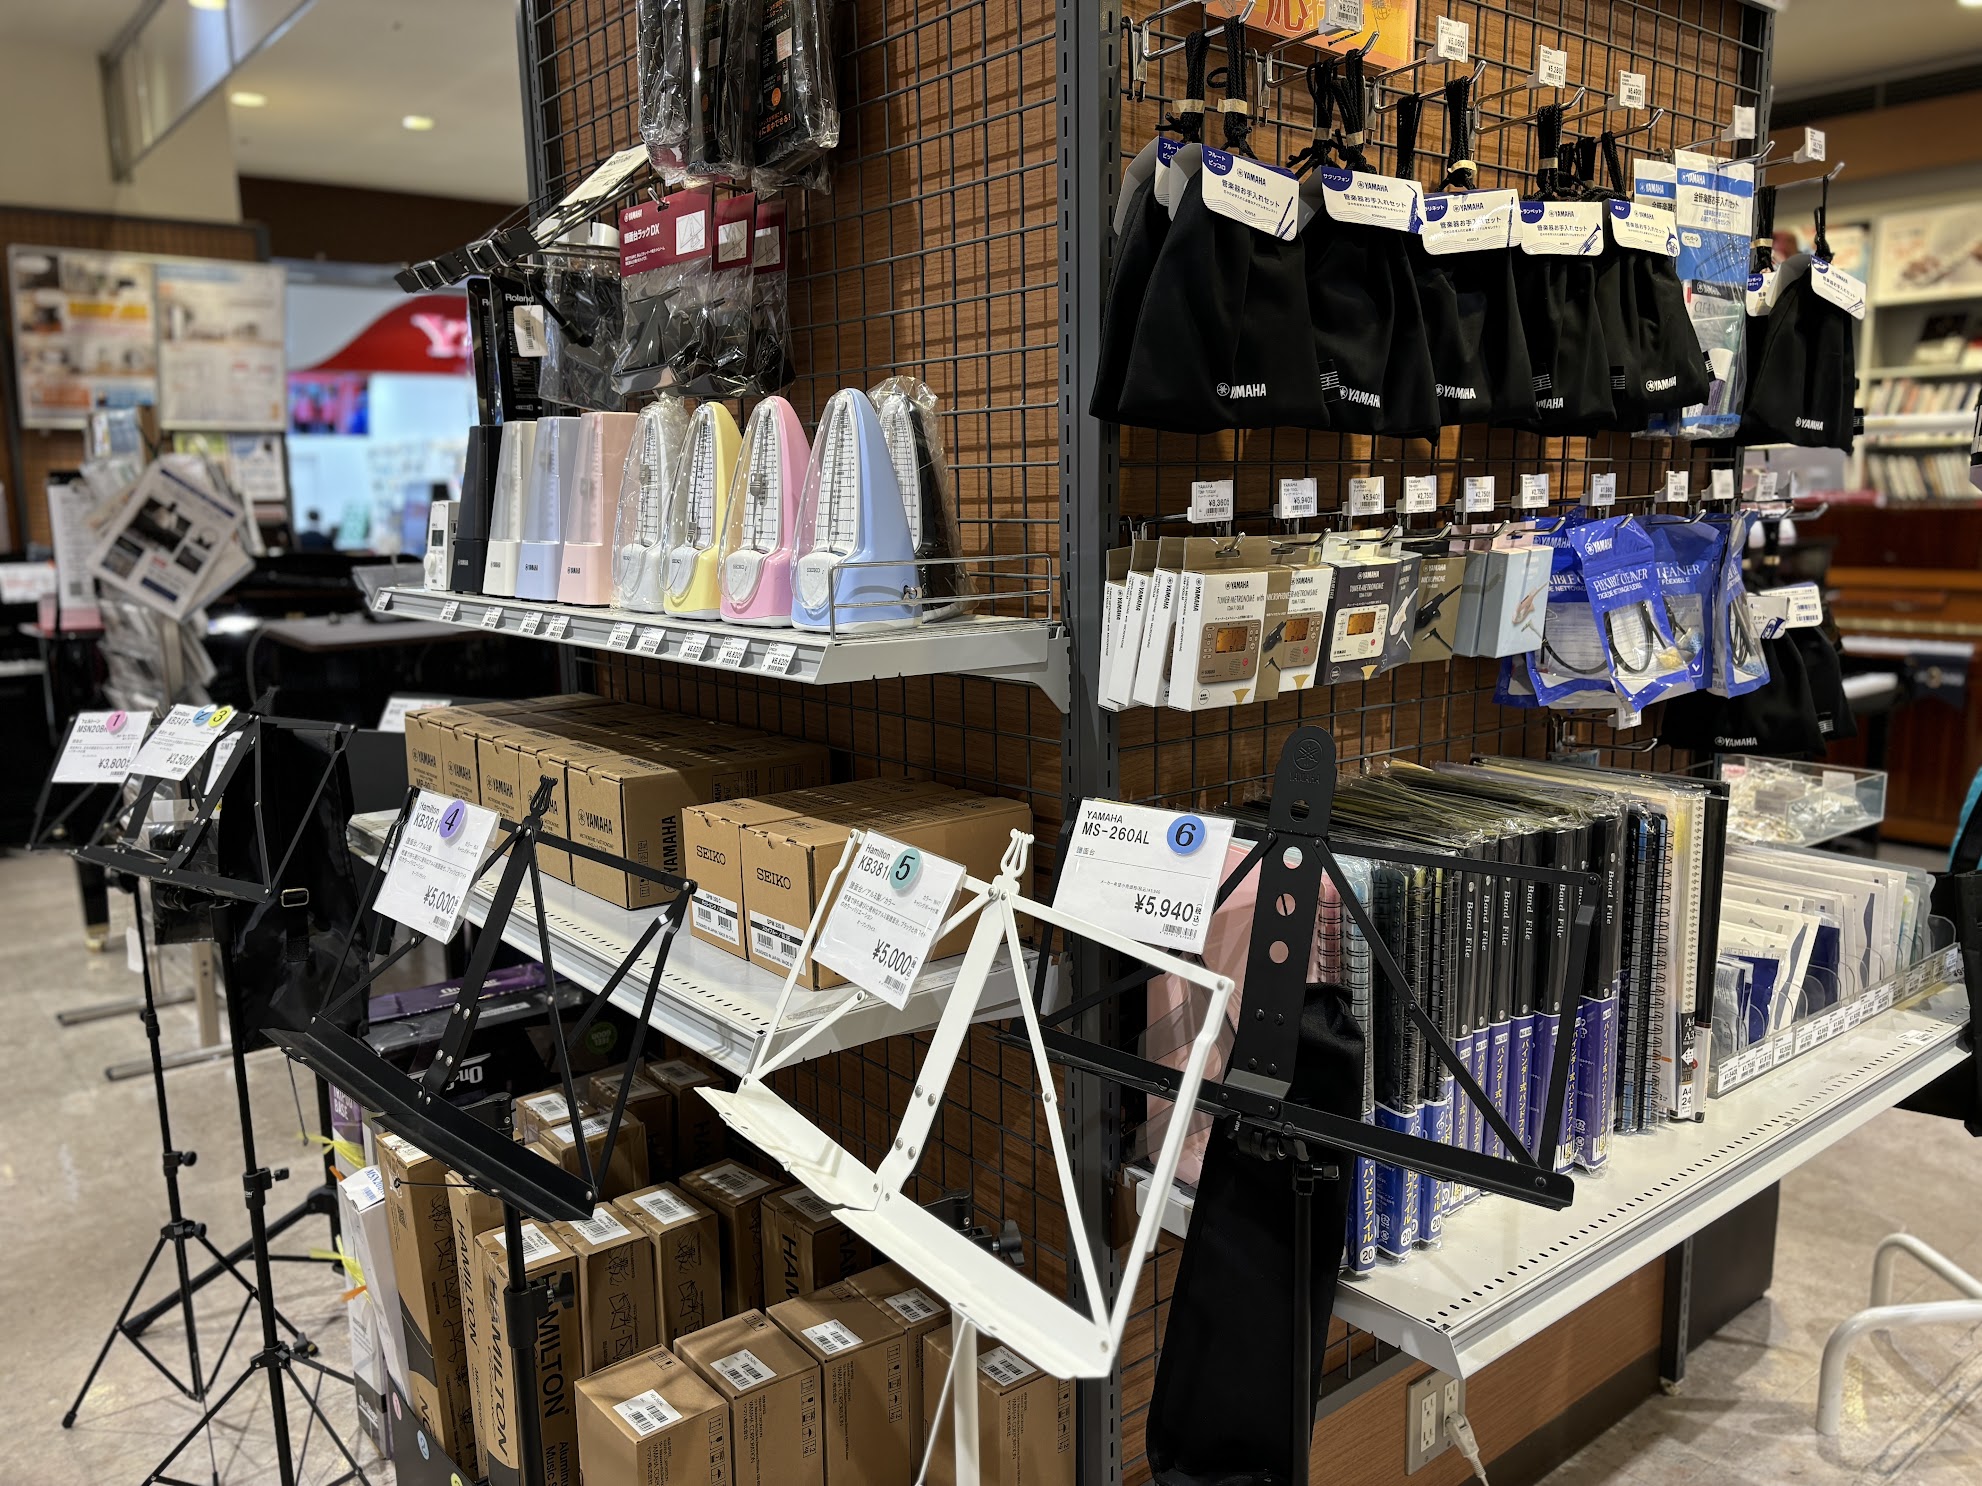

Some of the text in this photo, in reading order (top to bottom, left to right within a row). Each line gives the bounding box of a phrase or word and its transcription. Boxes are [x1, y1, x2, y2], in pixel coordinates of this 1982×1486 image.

[1207, 150, 1226, 161] フルート
[1244, 170, 1266, 187] YAMAHA
[1364, 182, 1389, 193] YAMAHA
[1686, 174, 1706, 185] YAMAHA
[1221, 178, 1280, 208] 管楽器お手入れセット
[1646, 183, 1665, 194] YAMAHA
[1343, 193, 1406, 208] 管楽器お手入れセット
[1460, 202, 1484, 212] YAMAHA
[505, 293, 535, 303] Roland
[1654, 375, 1677, 391] YAMAHA
[1443, 386, 1476, 400] YAMAHA
[1801, 419, 1823, 431] YAMAHA
[1540, 537, 1571, 548] YAMAHA
[1593, 538, 1613, 552] YAMAHA
[1231, 580, 1249, 589] YAMAHA
[1135, 587, 1144, 611] YAMAHA
[1163, 585, 1172, 610] YAMAHA
[1193, 586, 1202, 612] YAMAHA
[166, 716, 191, 727] KB341F
[213, 709, 227, 722] 3
[1724, 736, 1758, 748] YAMAHA
[97, 758, 126, 769] ¥3,800
[166, 753, 192, 766] ¥3,500
[418, 749, 437, 768] YAMAHA
[453, 764, 472, 781] YAMAHA
[492, 778, 514, 799] YAMAHA
[419, 802, 440, 815] Hamilton
[1087, 811, 1123, 824] YAMAHA
[445, 808, 460, 832] 4
[585, 812, 613, 835] YAMAHA
[1082, 821, 1150, 845] MS-260AL
[1175, 823, 1197, 847] 6
[661, 815, 679, 873] YAMAHA
[865, 842, 891, 861] Hamilton
[696, 844, 726, 866] SEIKO
[895, 855, 916, 881] 5
[756, 867, 792, 890] SEIKO
[423, 885, 456, 915] ¥5,000
[1606, 871, 1615, 925] Band File
[1134, 893, 1194, 923] ¥5,940
[1525, 885, 1535, 940] Band File
[1556, 884, 1567, 939] Band File
[1481, 895, 1491, 951] Band File
[1501, 891, 1511, 946] Band File
[1465, 901, 1474, 958] Band File
[872, 938, 913, 976] ¥5,000
[1683, 1031, 1695, 1041] A3
[334, 1098, 349, 1120] BASE
[1681, 1097, 1692, 1106] 24
[1362, 1162, 1375, 1244] バンドファイル
[1432, 1218, 1441, 1229] 20
[1402, 1230, 1411, 1242] 20
[1362, 1249, 1373, 1262] 20
[457, 1218, 479, 1347] HAMILTON
[489, 1274, 509, 1458] HAMILTON
[546, 1445, 557, 1481] Music
